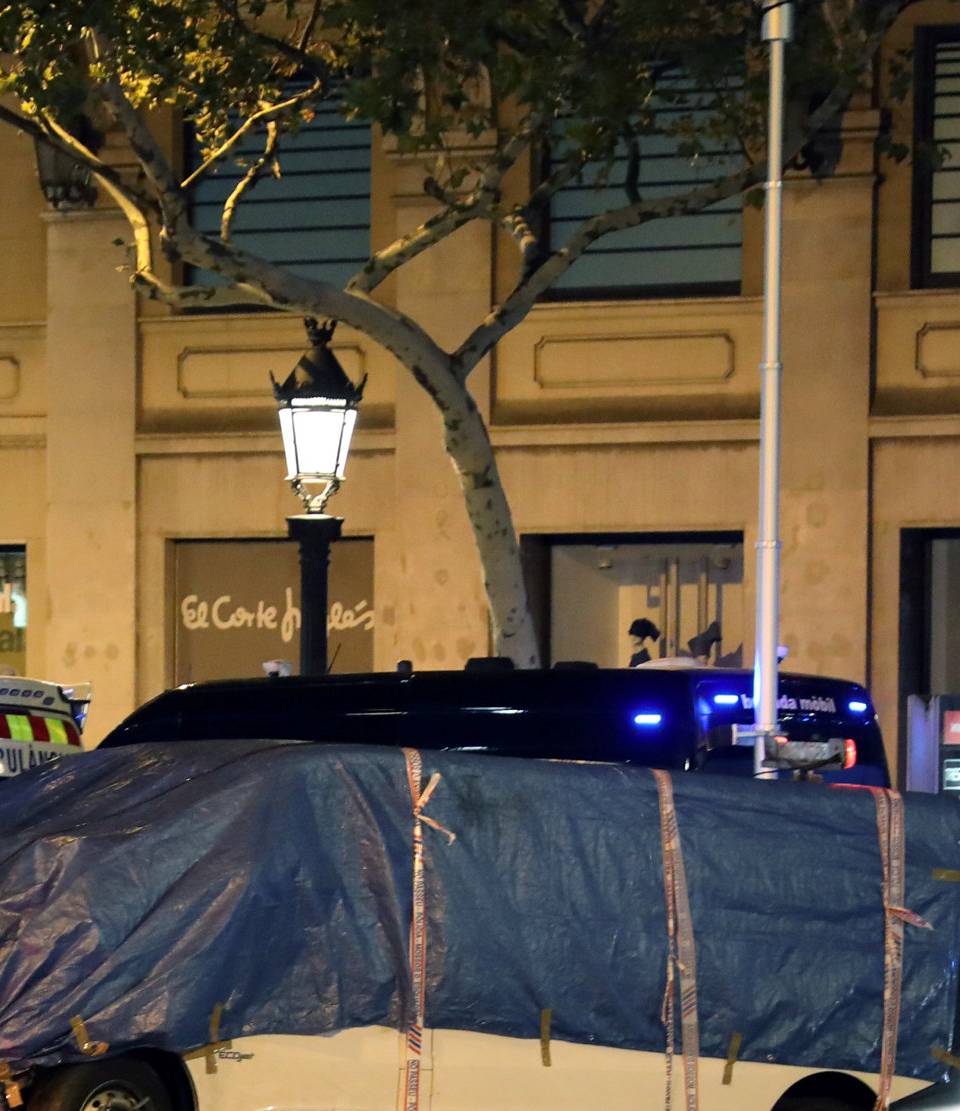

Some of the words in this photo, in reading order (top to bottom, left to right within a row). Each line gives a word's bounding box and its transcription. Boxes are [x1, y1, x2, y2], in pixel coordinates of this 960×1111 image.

[181, 594, 210, 630] El
[211, 595, 278, 630] Corte
[281, 587, 375, 643] Inlés
